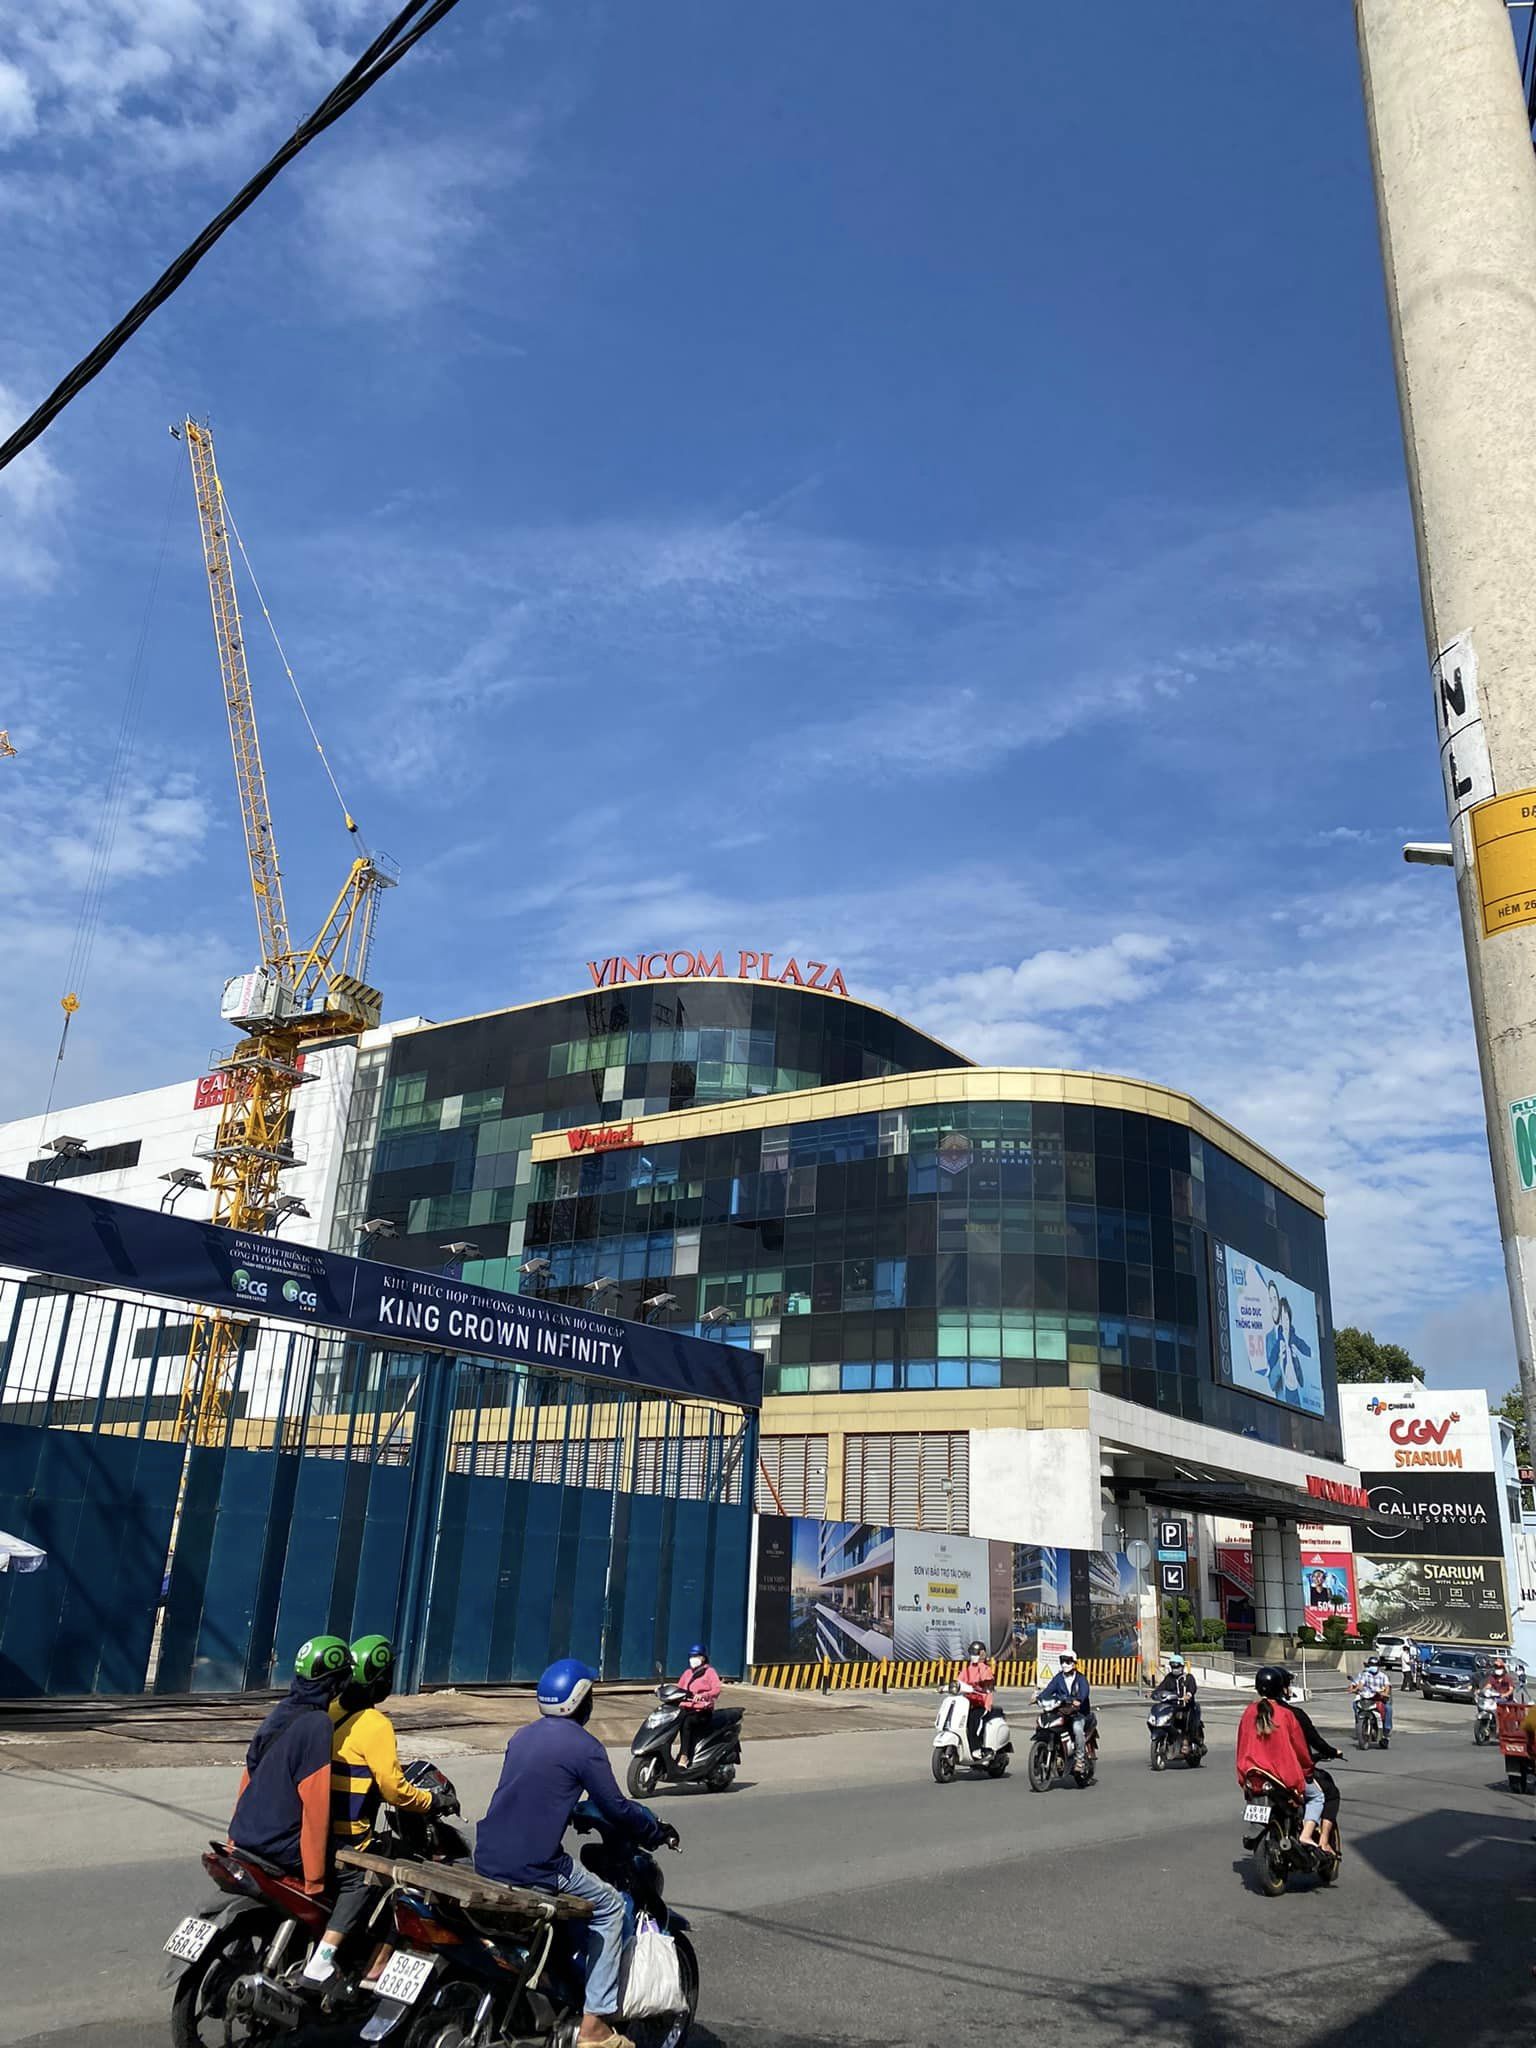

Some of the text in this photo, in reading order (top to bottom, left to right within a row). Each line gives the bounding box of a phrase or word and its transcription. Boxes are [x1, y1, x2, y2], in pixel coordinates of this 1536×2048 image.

[587, 951, 850, 996] VINCOM PLAZA
[229, 1248, 250, 1260] CÔNG
[237, 1278, 268, 1297] BCG
[289, 1288, 317, 1306] BCG
[383, 1276, 409, 1291] KHU
[412, 1281, 443, 1299] PHỨC
[446, 1289, 469, 1304] HỢP
[470, 1296, 515, 1314] THƯƠNG
[517, 1305, 536, 1319] MẠI
[588, 1321, 606, 1335] CAO
[607, 1324, 625, 1338] CẤP
[378, 1295, 623, 1368] KING CROWN INFINITY
[1389, 1418, 1450, 1445] CGV
[1394, 1448, 1463, 1468] STARIUM
[1378, 1502, 1486, 1516] CALIFORNIA
[1165, 1525, 1177, 1544] P
[1424, 1564, 1485, 1582] STARIUM
